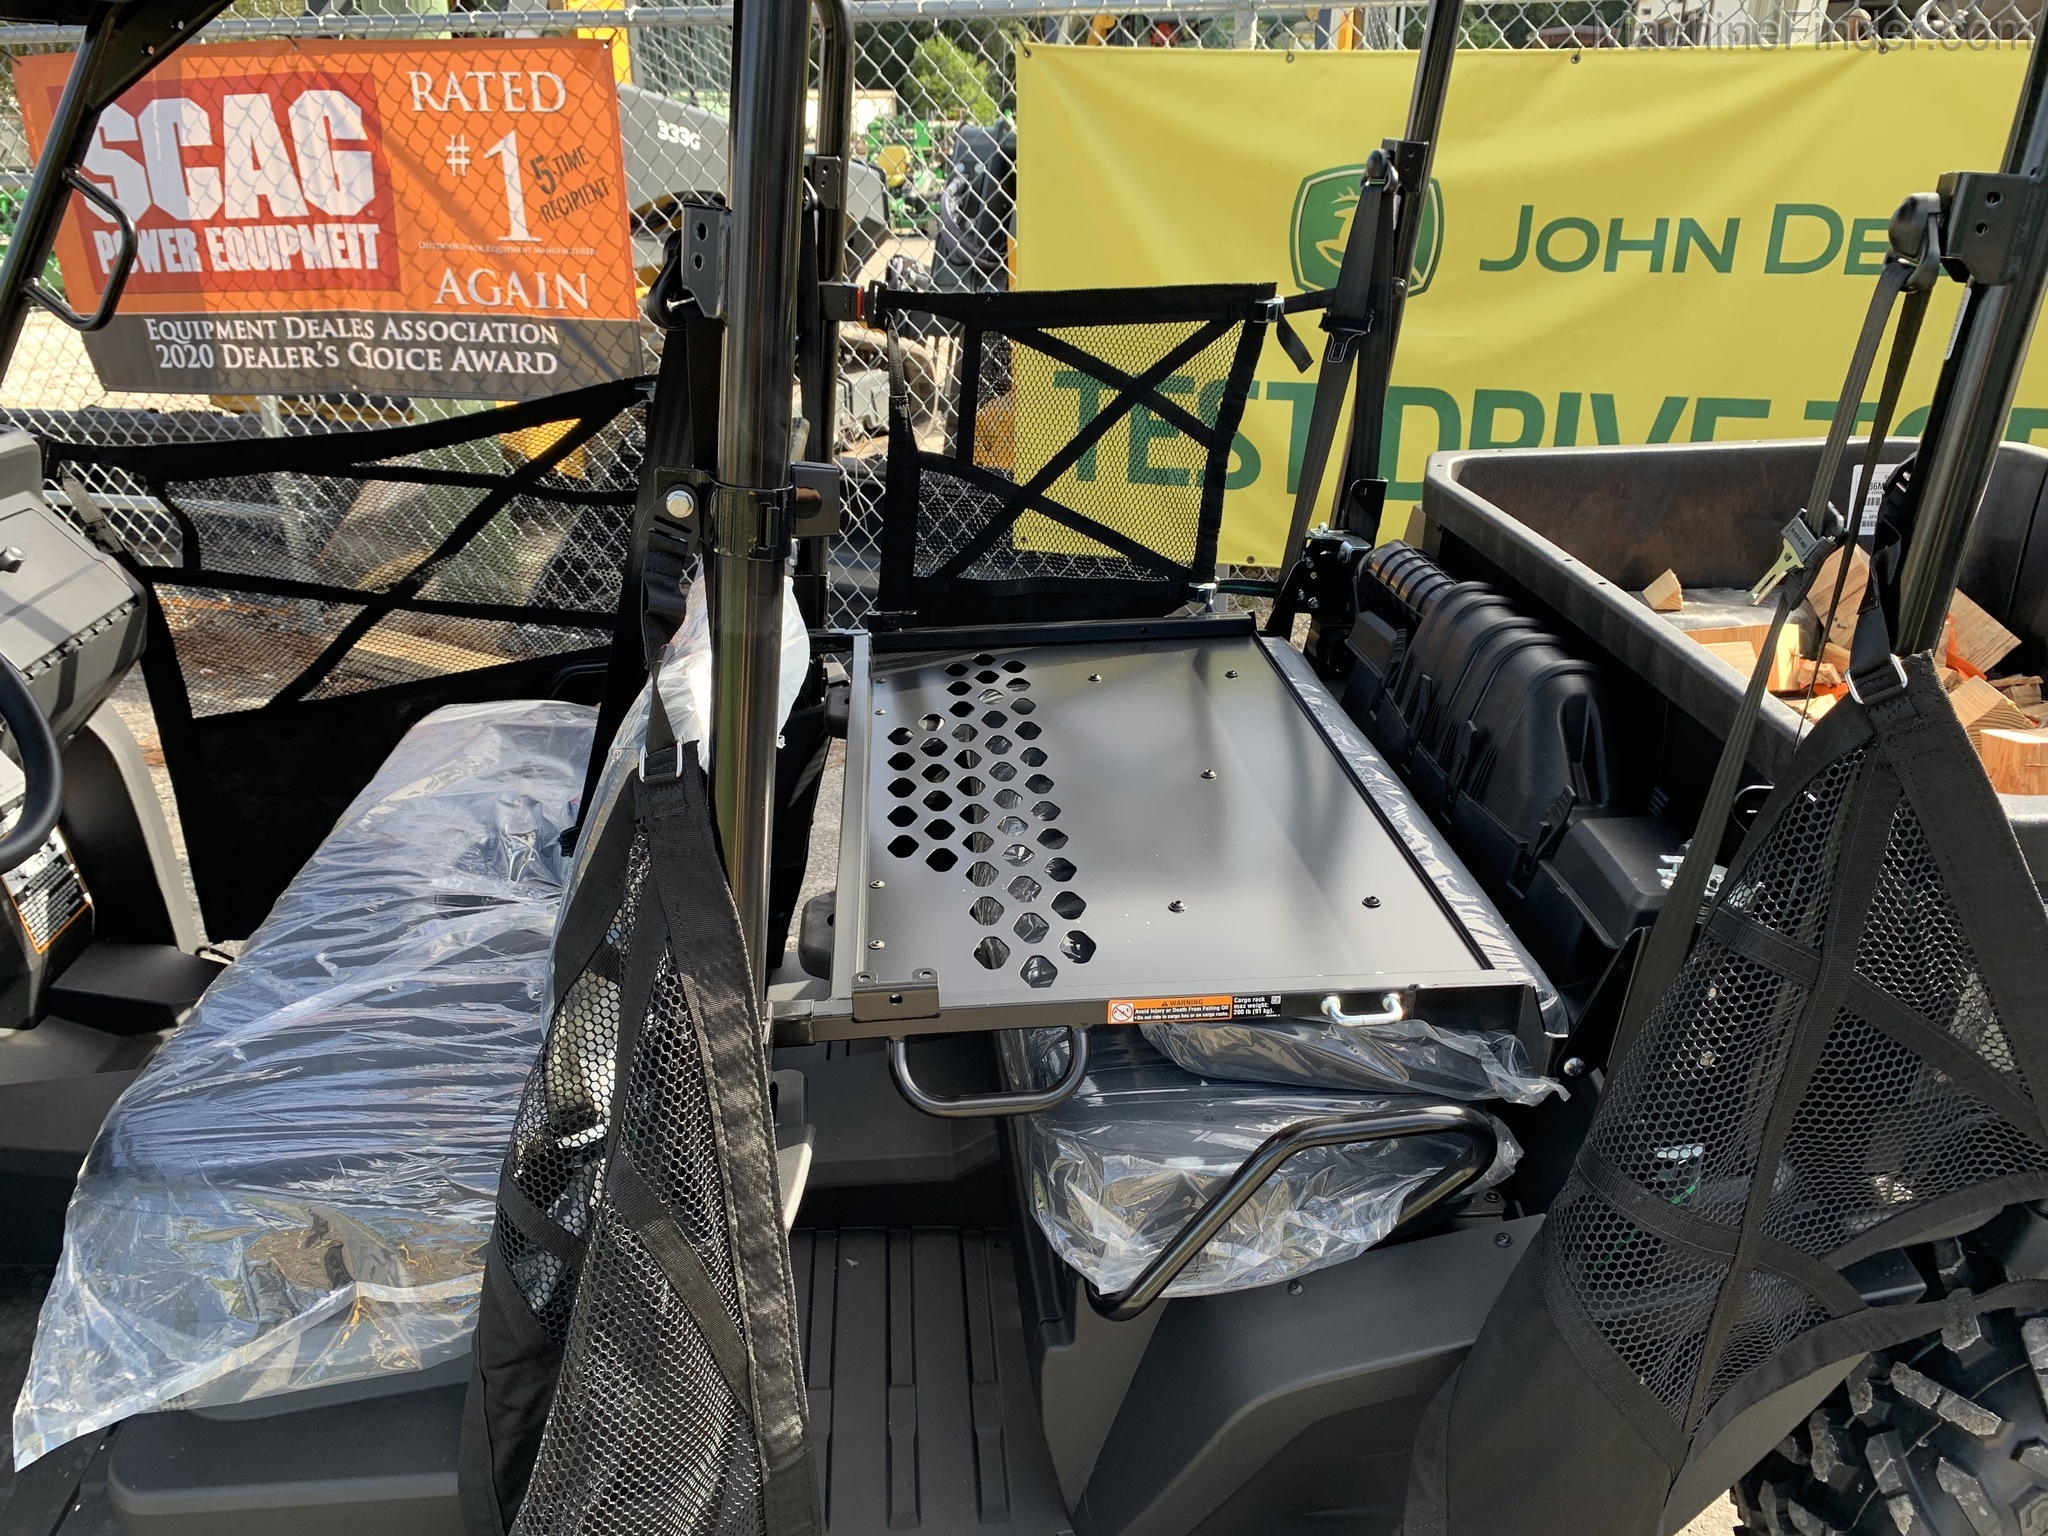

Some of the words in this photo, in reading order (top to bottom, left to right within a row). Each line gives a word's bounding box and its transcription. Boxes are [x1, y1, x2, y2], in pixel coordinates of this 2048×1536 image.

[406, 70, 567, 113] RATED
[81, 90, 375, 223] SCAG
[540, 176, 610, 224] RECIPIENT
[1479, 204, 1741, 274] JOHN
[433, 267, 589, 310] AGAIN
[144, 317, 277, 344] EQUIPMENT
[382, 316, 560, 345] ASSOCIATION
[156, 343, 215, 369] 2020
[220, 341, 341, 369] DEALER'S
[450, 345, 558, 375] AWARD
[1170, 999, 1204, 1007] WARNING
